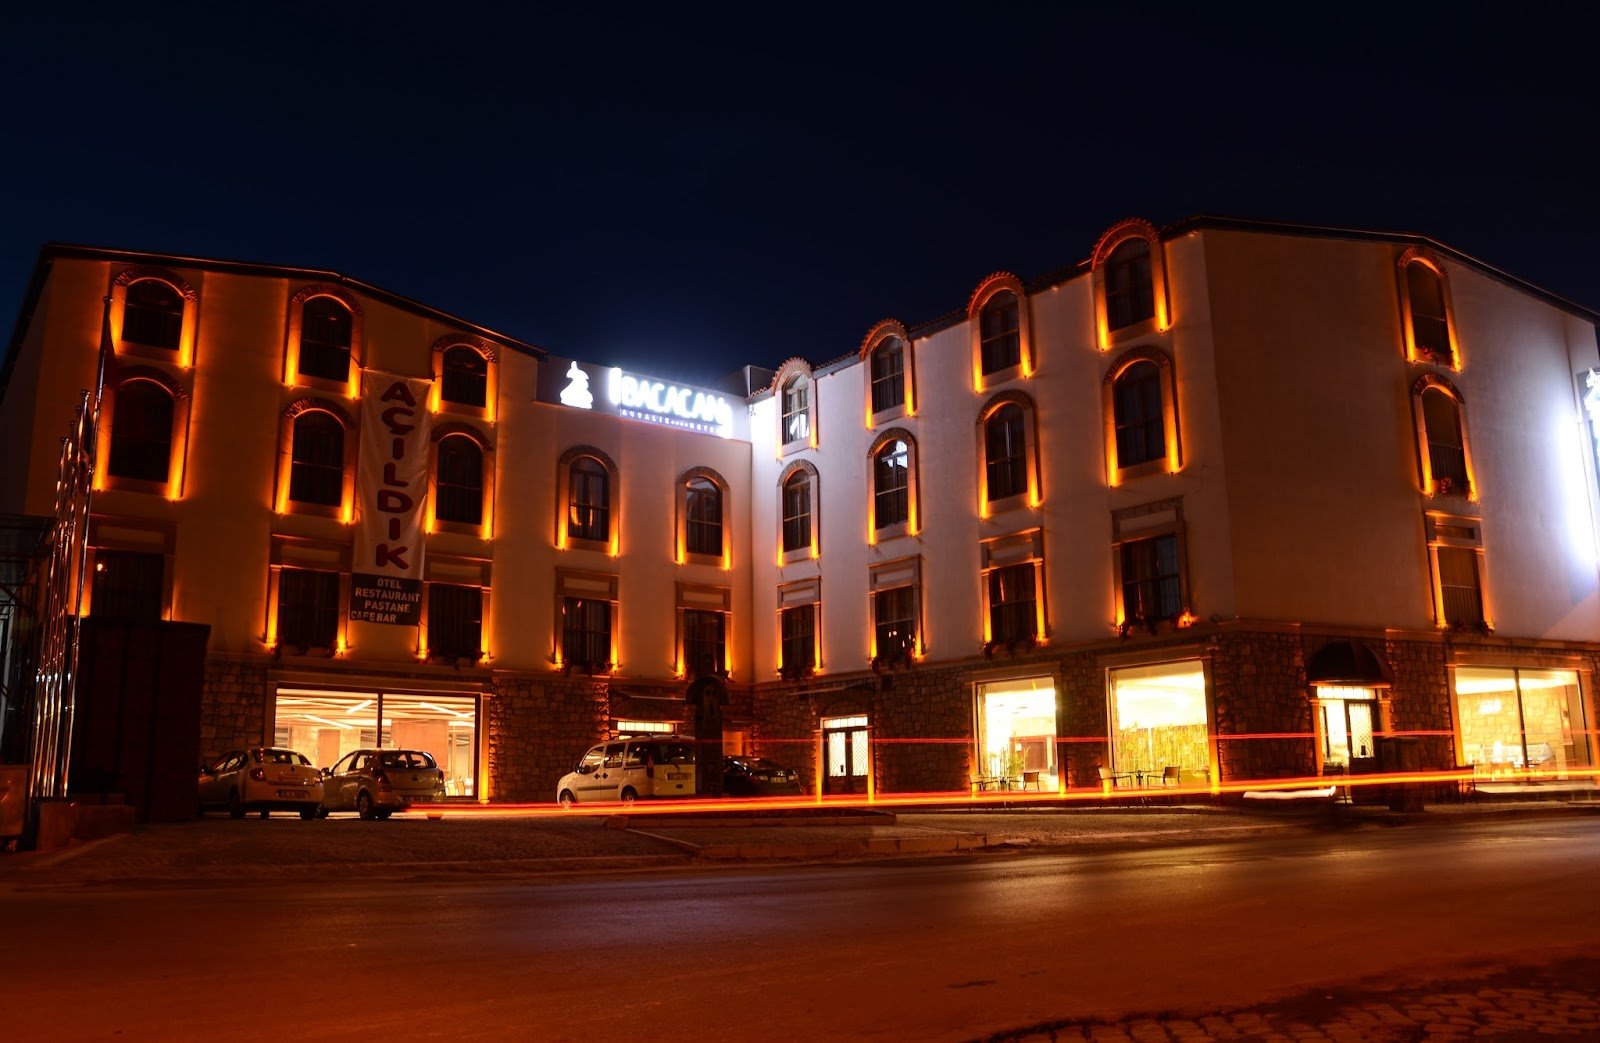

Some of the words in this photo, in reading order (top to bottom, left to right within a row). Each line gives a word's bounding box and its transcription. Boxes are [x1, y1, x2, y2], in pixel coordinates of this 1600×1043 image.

[689, 422, 721, 435] HOTE
[375, 381, 416, 570] AÇILDIK
[377, 578, 402, 589] OTEL
[355, 587, 420, 602] RESTAURANT
[364, 599, 411, 613] PASTANE
